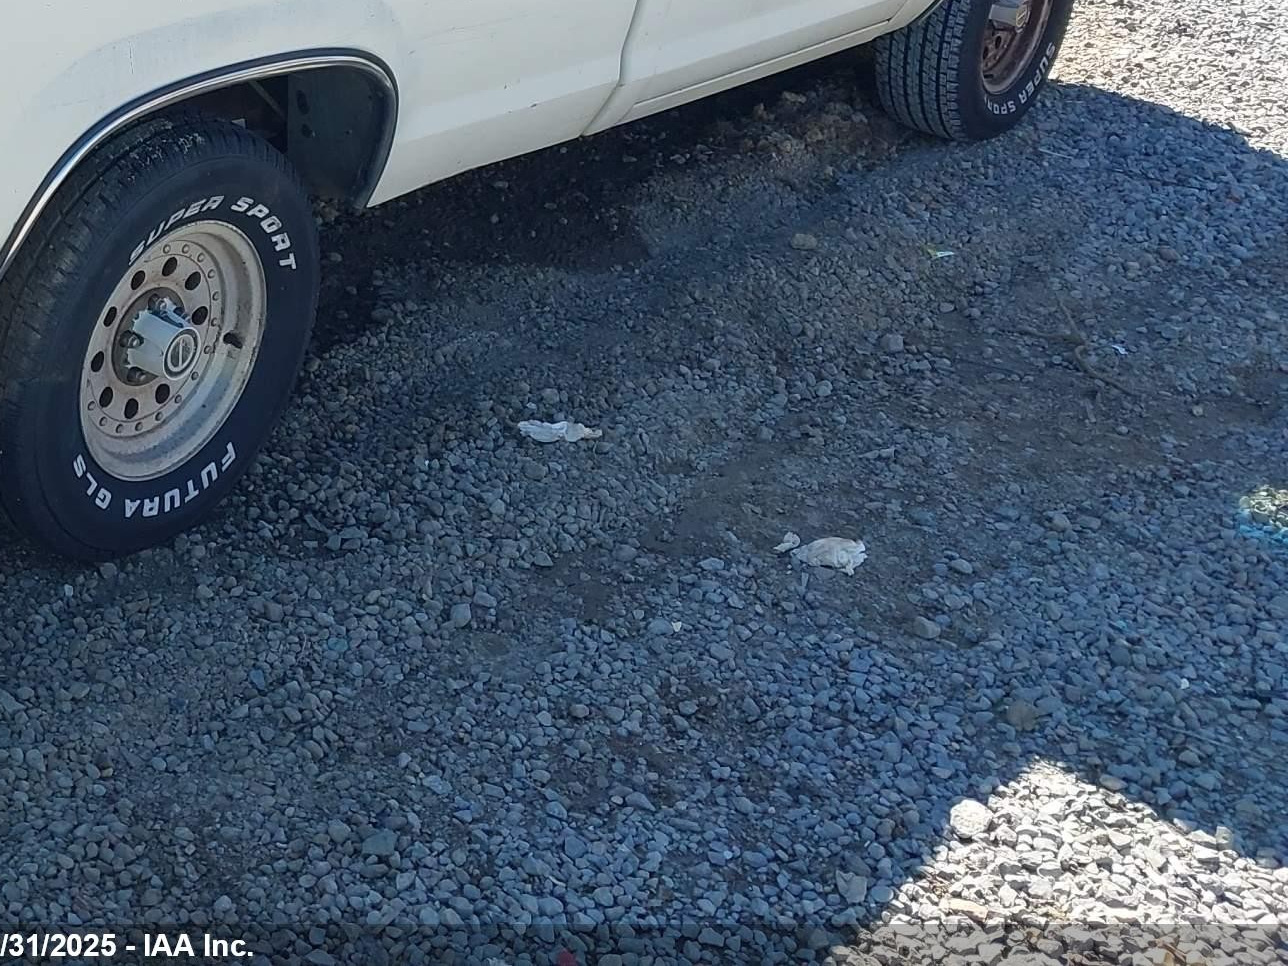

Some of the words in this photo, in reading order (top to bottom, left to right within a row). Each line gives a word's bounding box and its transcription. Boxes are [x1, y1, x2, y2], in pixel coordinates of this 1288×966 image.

[1018, 42, 1056, 105] SUPER
[128, 195, 224, 266] SUPER
[230, 196, 297, 270] SPORT
[72, 453, 113, 510] GLS
[124, 441, 237, 518] FUTURA
